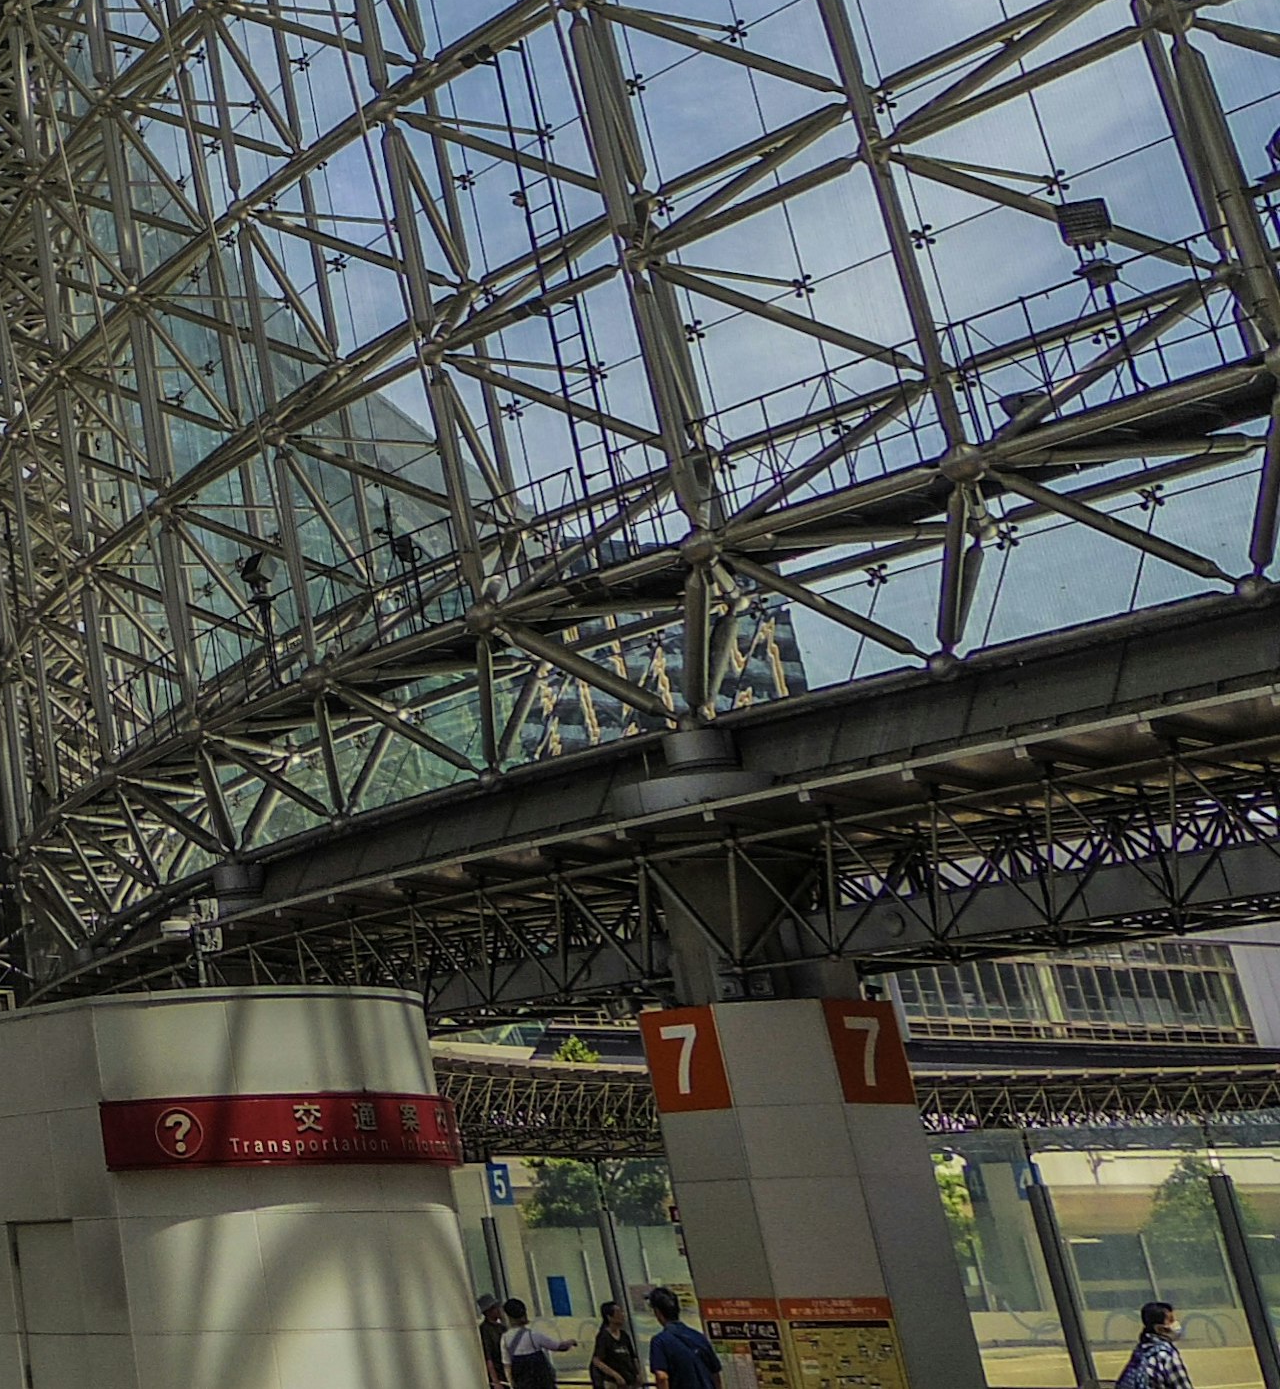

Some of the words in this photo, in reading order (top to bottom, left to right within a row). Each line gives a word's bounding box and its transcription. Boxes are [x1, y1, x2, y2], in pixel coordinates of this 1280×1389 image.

[660, 1023, 697, 1095] 7
[843, 1016, 881, 1087] 7
[292, 1101, 460, 1135] 交通案内
[229, 1136, 390, 1156] Transportation
[492, 1169, 507, 1199] 5
